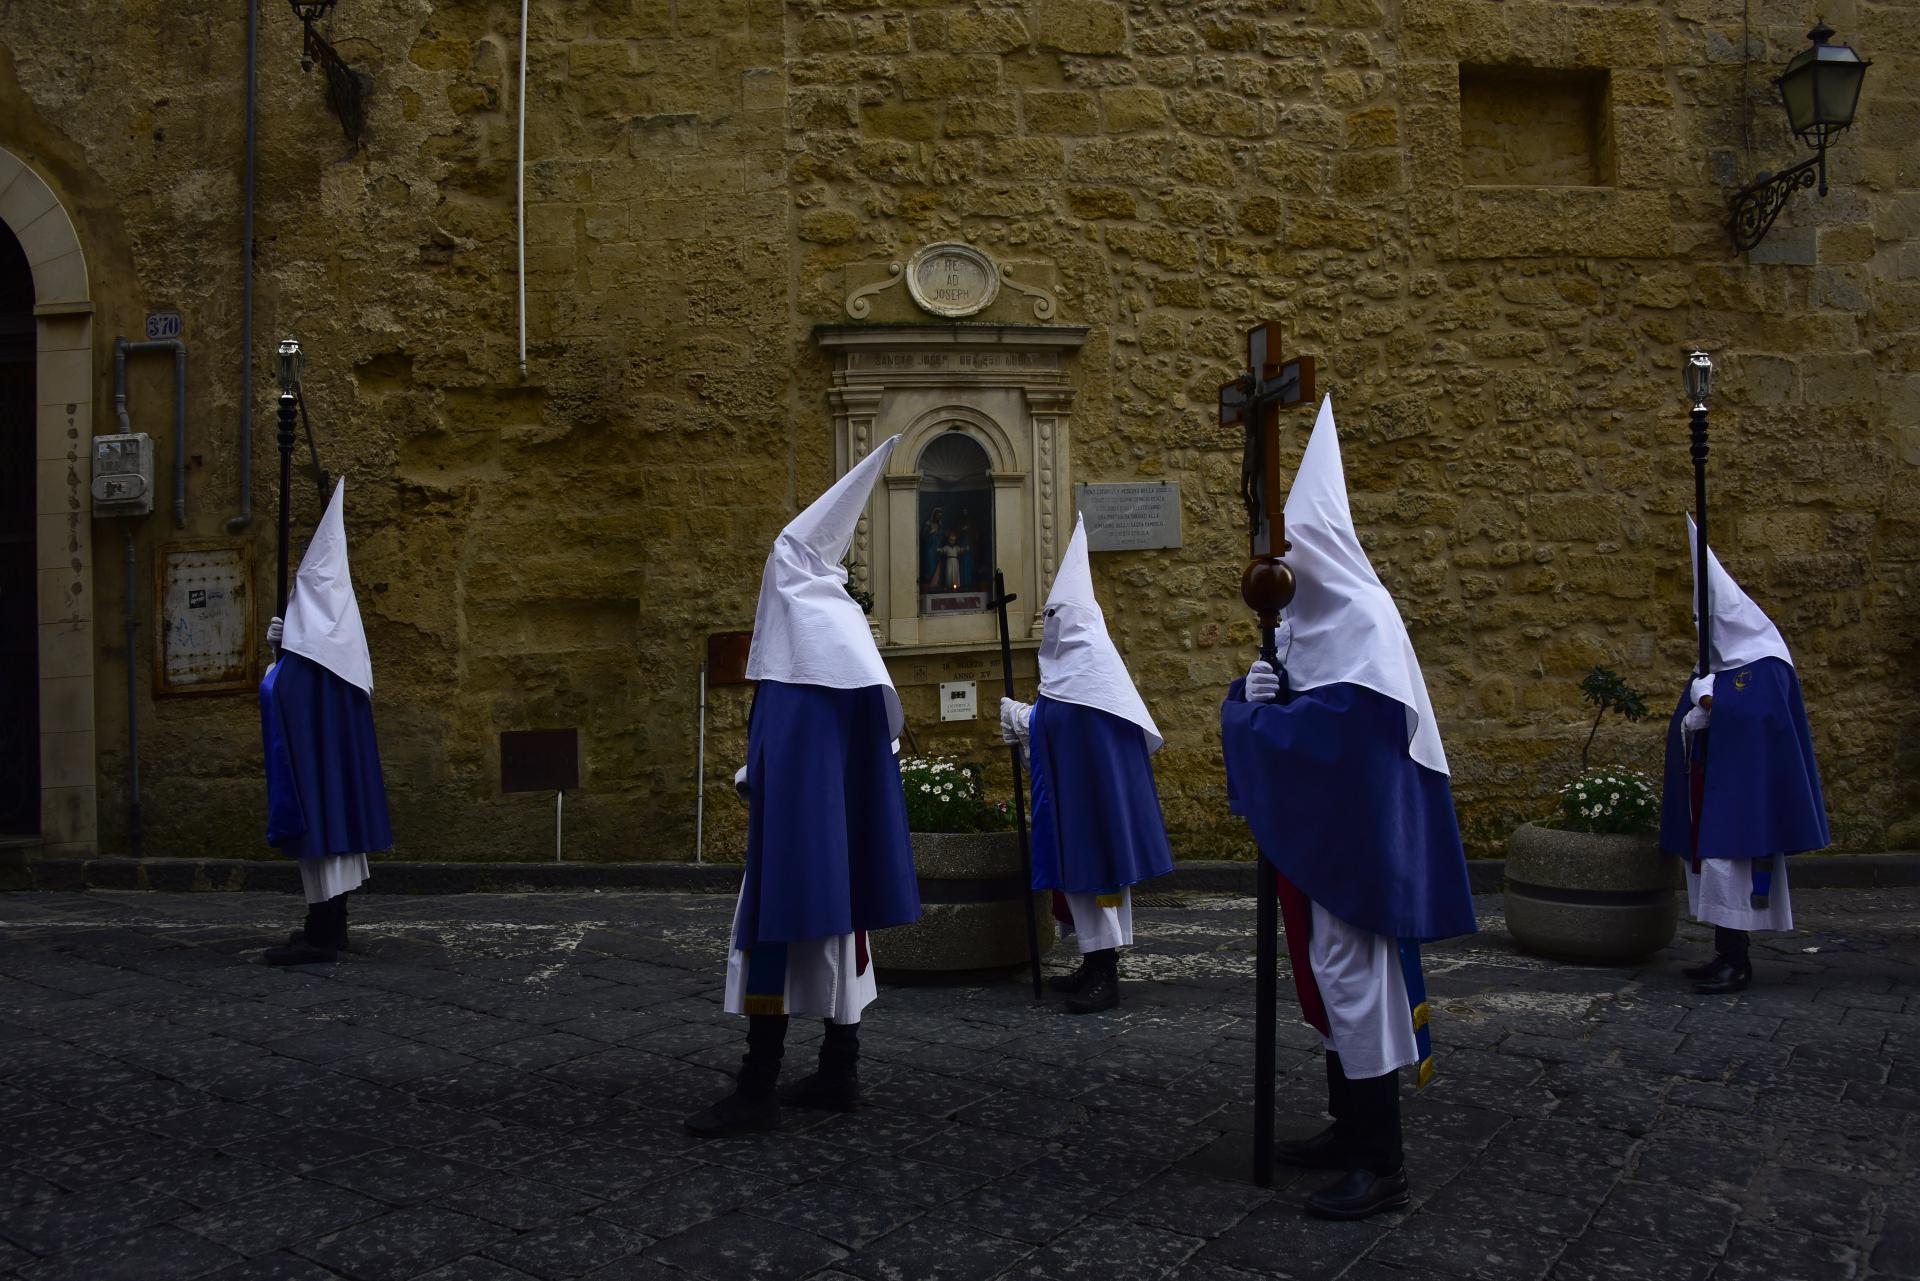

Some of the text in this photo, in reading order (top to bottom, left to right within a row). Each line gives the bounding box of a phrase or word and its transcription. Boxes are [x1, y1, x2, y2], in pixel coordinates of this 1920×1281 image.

[945, 259, 959, 272] ITE
[947, 275, 959, 286] AD
[934, 289, 969, 301] JOSEPH
[148, 316, 179, 337] 370
[953, 672, 975, 680] ANNO
